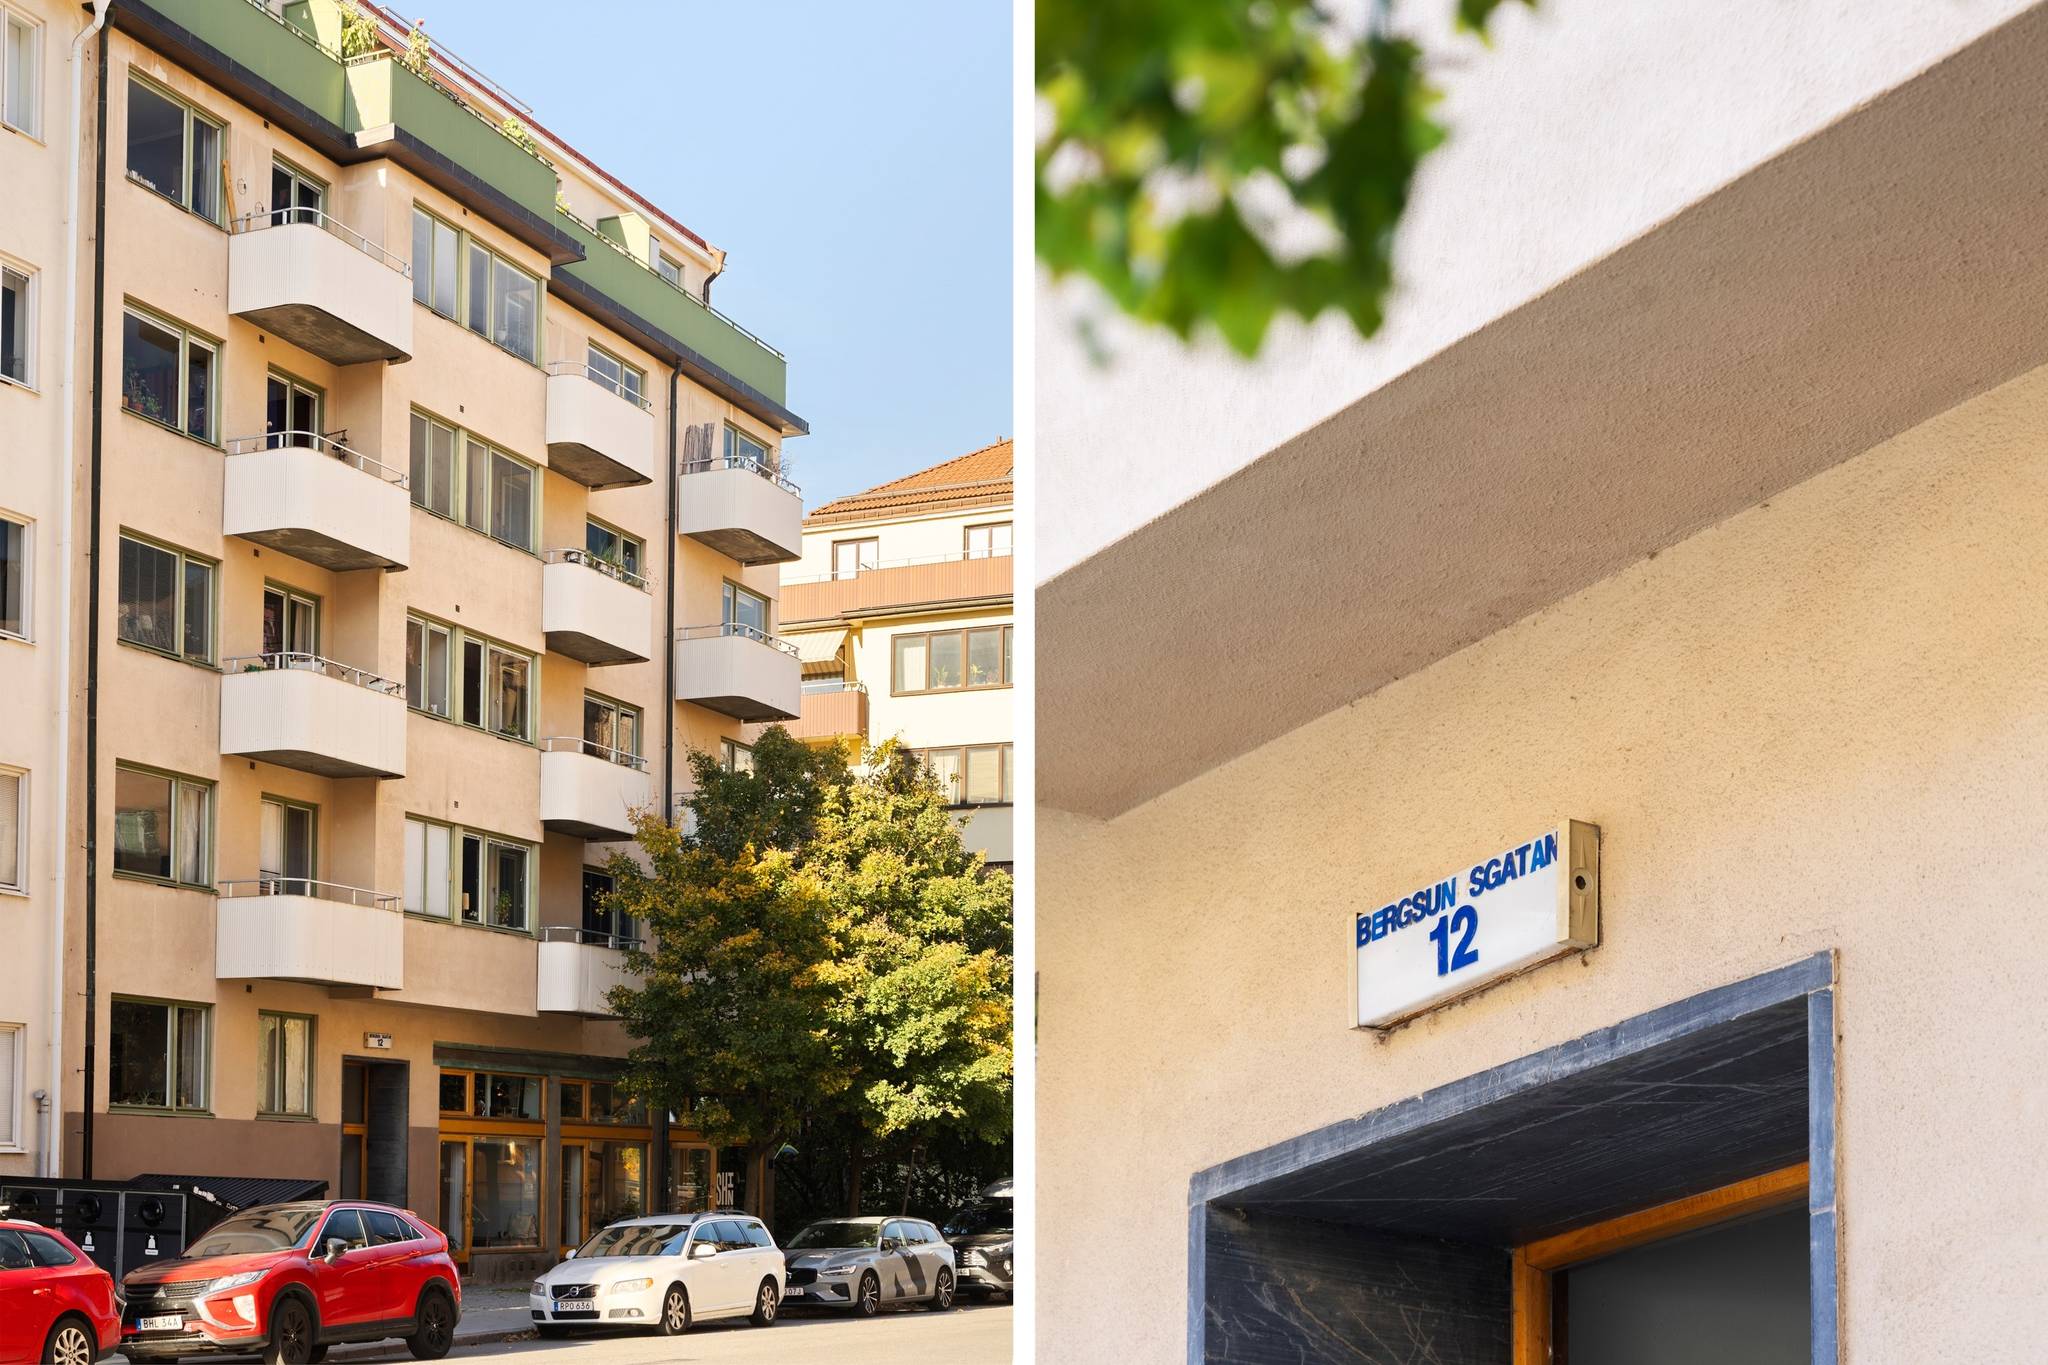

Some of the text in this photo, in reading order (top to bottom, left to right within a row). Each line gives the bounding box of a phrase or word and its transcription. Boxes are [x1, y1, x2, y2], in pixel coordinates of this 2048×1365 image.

[1357, 831, 1559, 949] BERGSUN SGATAN
[1429, 905, 1479, 976] 12
[143, 1319, 159, 1329] BHL
[576, 1302, 590, 1310] 636
